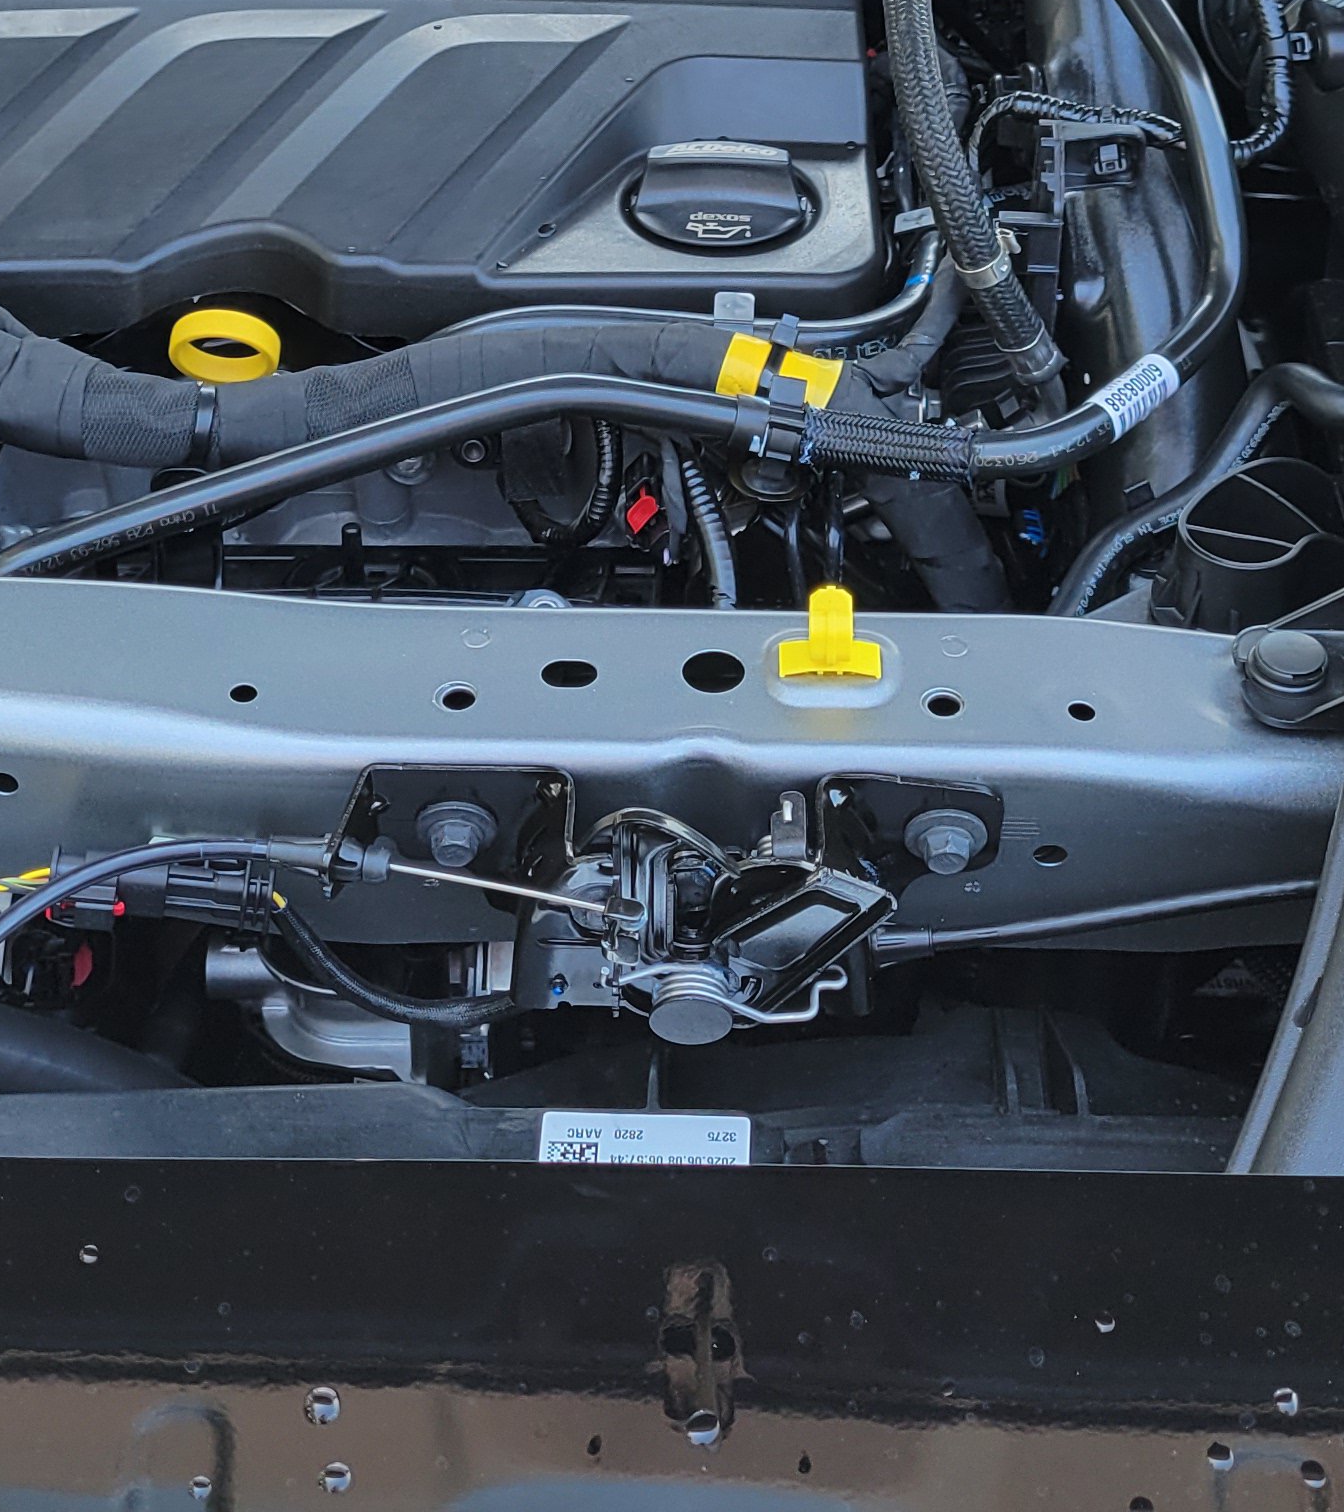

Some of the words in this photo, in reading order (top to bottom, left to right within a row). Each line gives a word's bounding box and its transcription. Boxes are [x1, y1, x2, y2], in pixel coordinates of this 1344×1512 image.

[663, 142, 779, 157] ACDelco
[689, 211, 753, 223] dexos
[1105, 362, 1163, 412] 60008388
[567, 1127, 603, 1139] AARC
[613, 1128, 644, 1140] 2820
[707, 1130, 738, 1143] 3275
